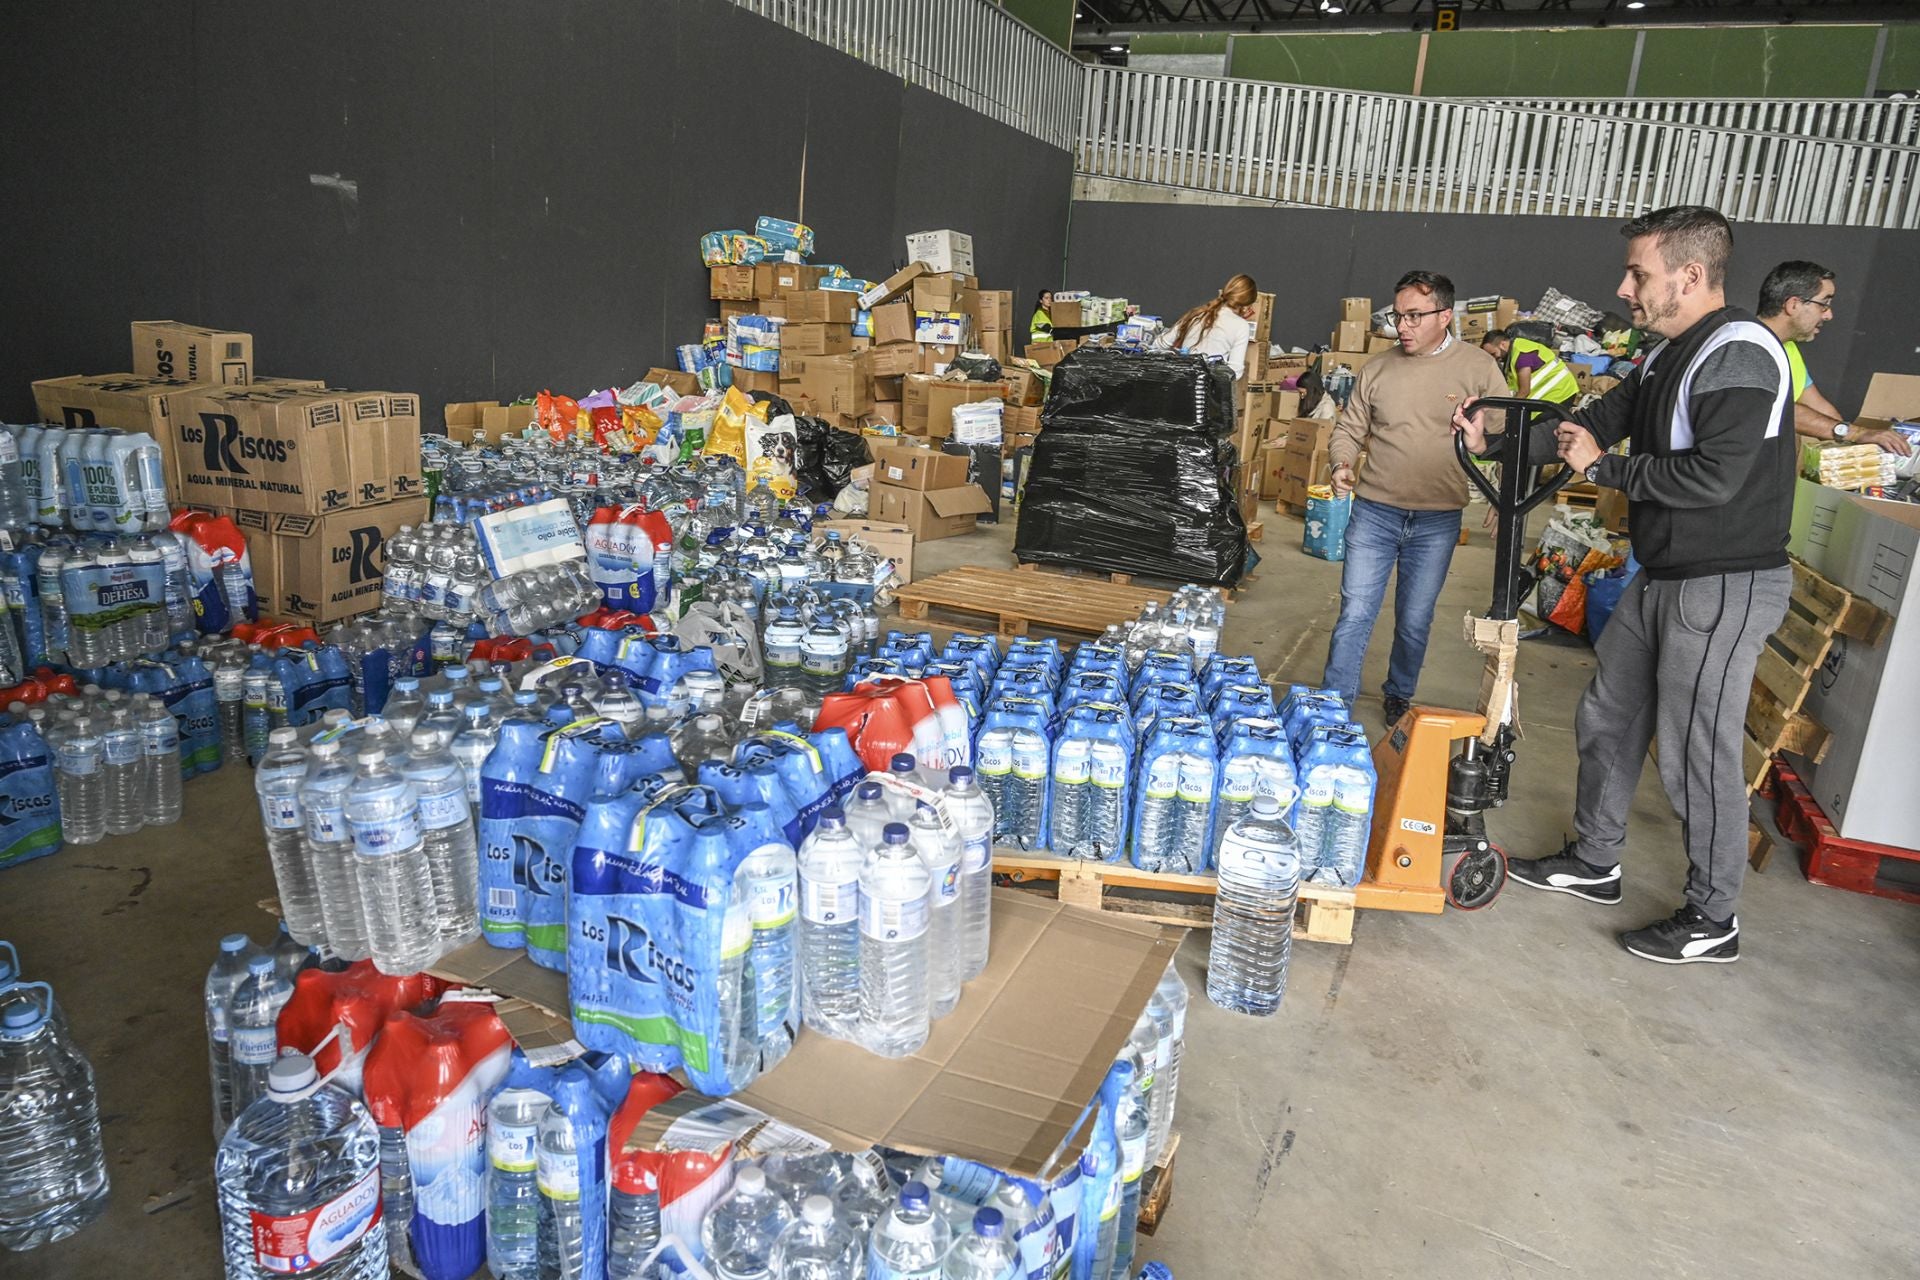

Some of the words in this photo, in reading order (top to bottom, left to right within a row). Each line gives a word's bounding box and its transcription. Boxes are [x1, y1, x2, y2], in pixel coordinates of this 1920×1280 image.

[1437, 10, 1456, 32] B
[83, 466, 115, 485] 100%
[187, 474, 213, 486] AGUA
[216, 476, 258, 490] MINERAL
[260, 481, 302, 495] NATURAL
[101, 587, 146, 605] DEHESA
[331, 590, 353, 603] AGUA
[319, 1185, 376, 1230] AGUADOY
